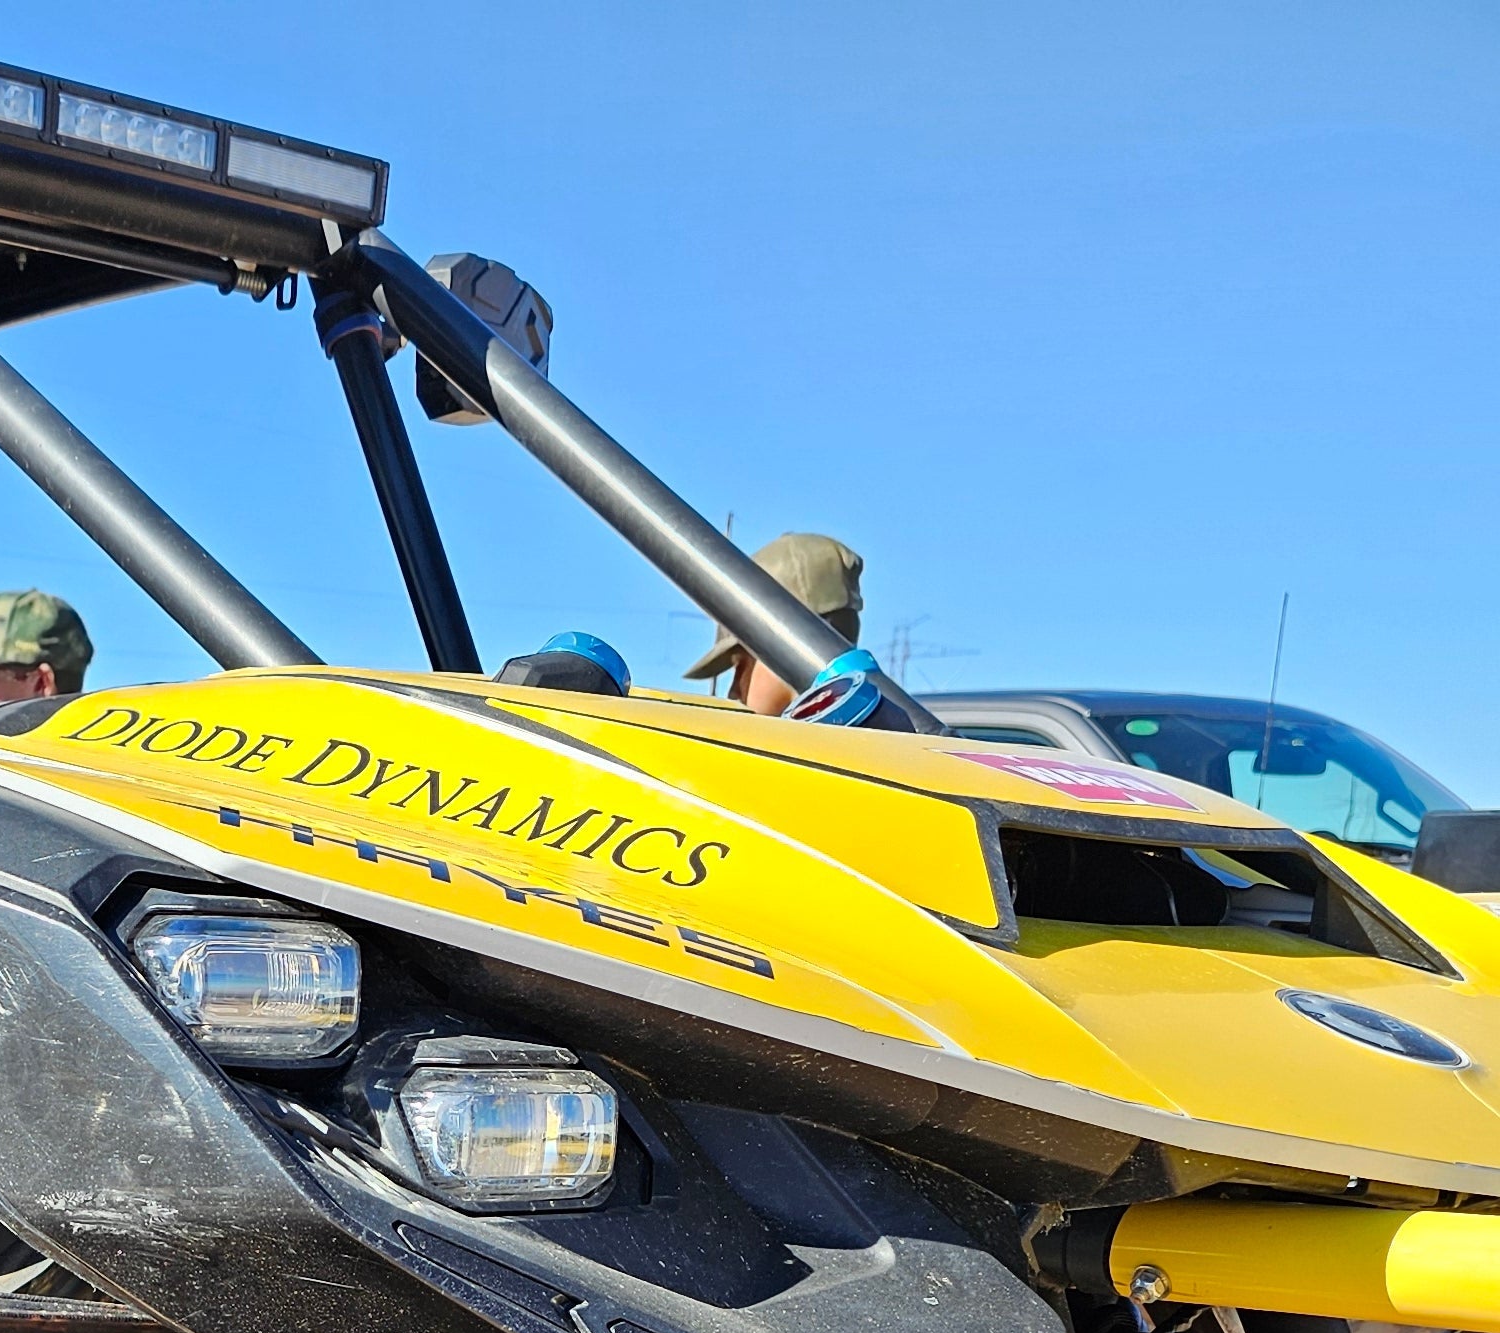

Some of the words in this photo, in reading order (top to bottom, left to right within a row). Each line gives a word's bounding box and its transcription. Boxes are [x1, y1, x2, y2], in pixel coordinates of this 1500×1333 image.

[59, 707, 295, 773] DIODE
[281, 738, 731, 887] DYNAMICS
[218, 805, 775, 980] HAYES
